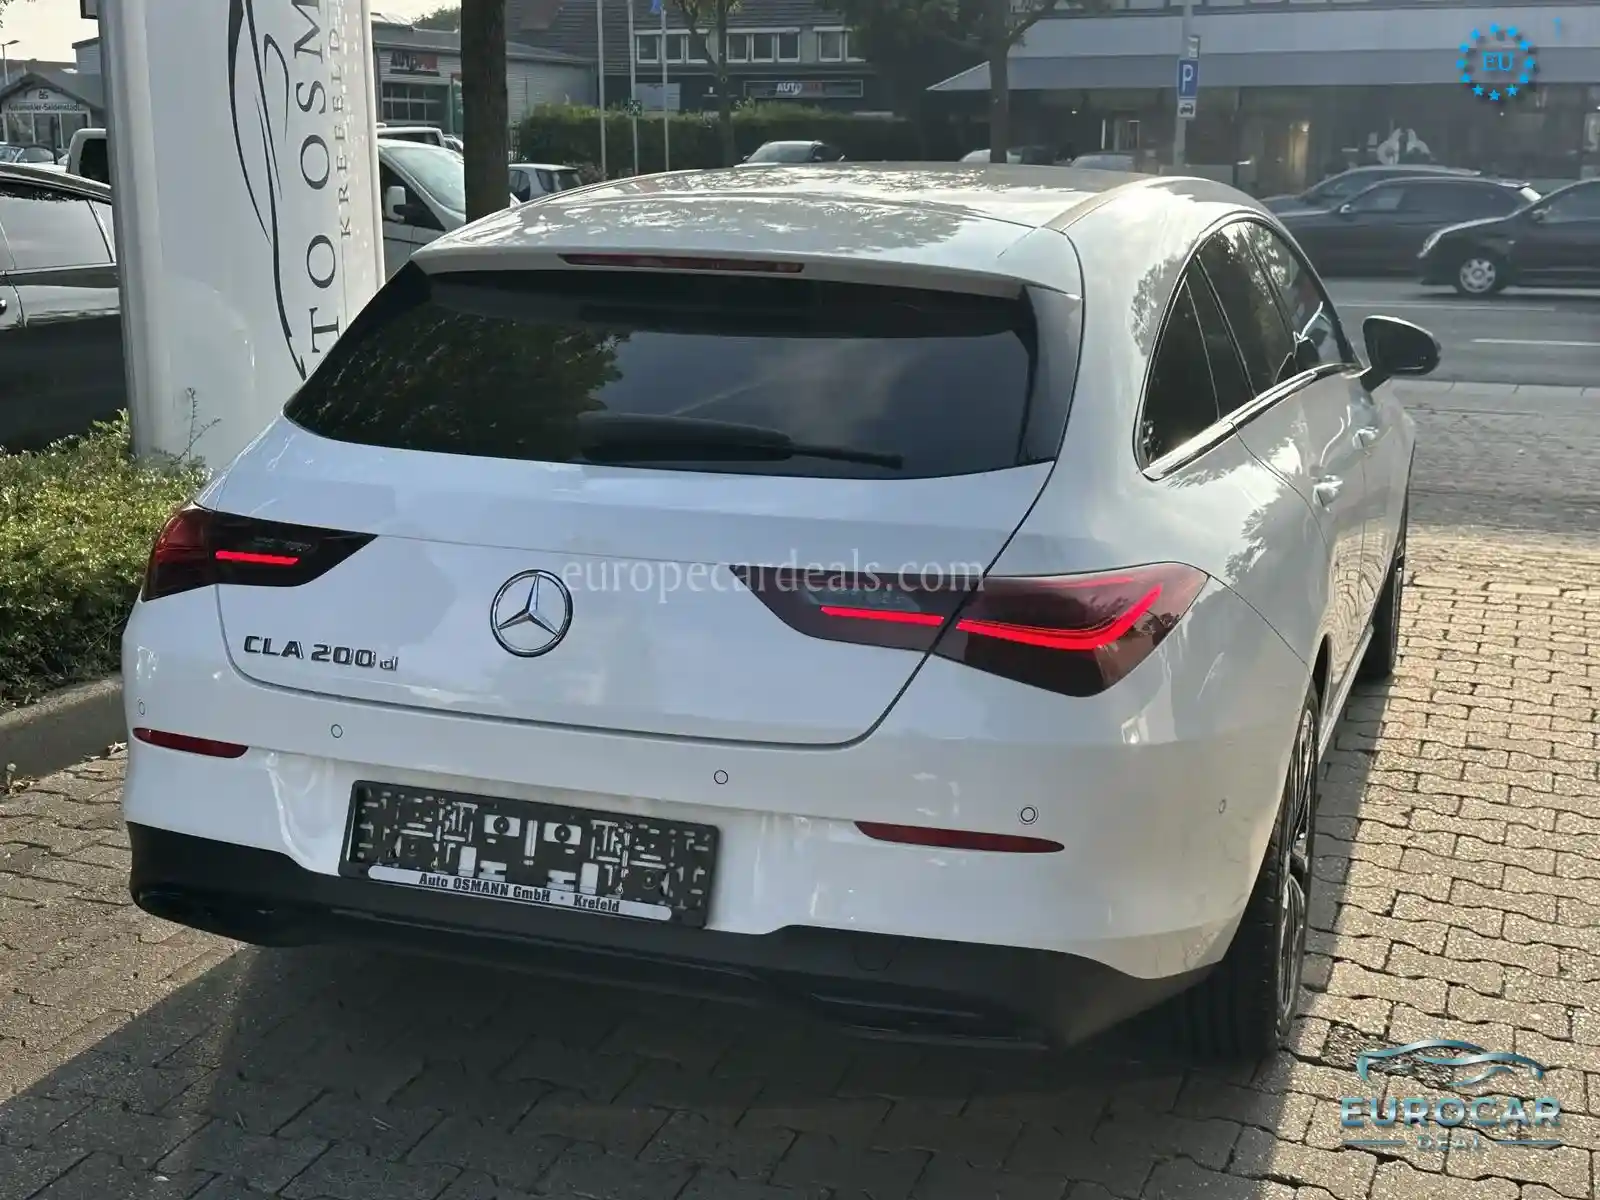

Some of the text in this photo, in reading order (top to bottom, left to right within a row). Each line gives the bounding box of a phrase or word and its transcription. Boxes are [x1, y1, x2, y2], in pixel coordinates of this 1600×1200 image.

[1182, 64, 1194, 93] P
[243, 635, 304, 660] CLA
[419, 873, 620, 912] Auto OSMANN GmbH Krefeld
